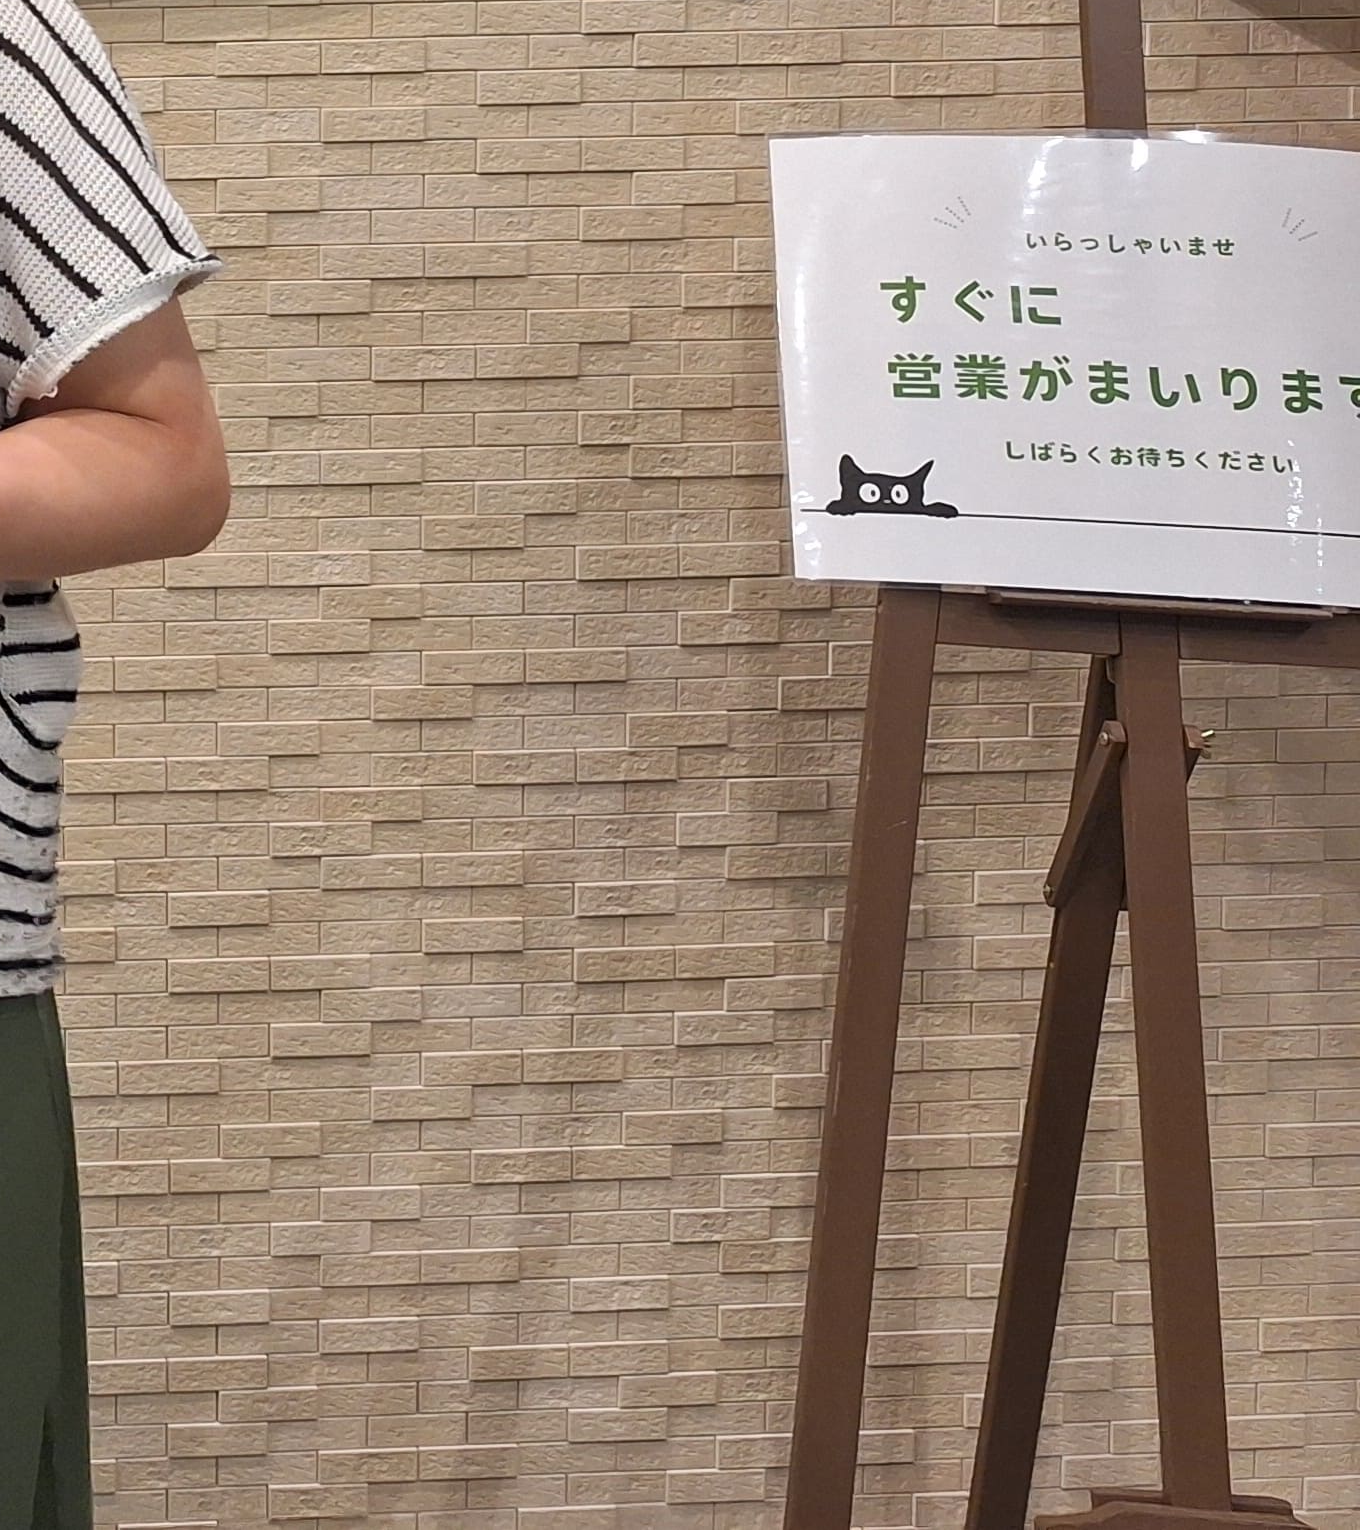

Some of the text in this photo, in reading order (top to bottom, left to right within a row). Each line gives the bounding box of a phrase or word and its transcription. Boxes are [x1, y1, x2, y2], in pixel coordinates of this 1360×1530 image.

[1025, 230, 1236, 257] いらっしゃいませ
[879, 275, 1063, 326] すぐに
[1005, 440, 1295, 474] しばらくお待ちください
